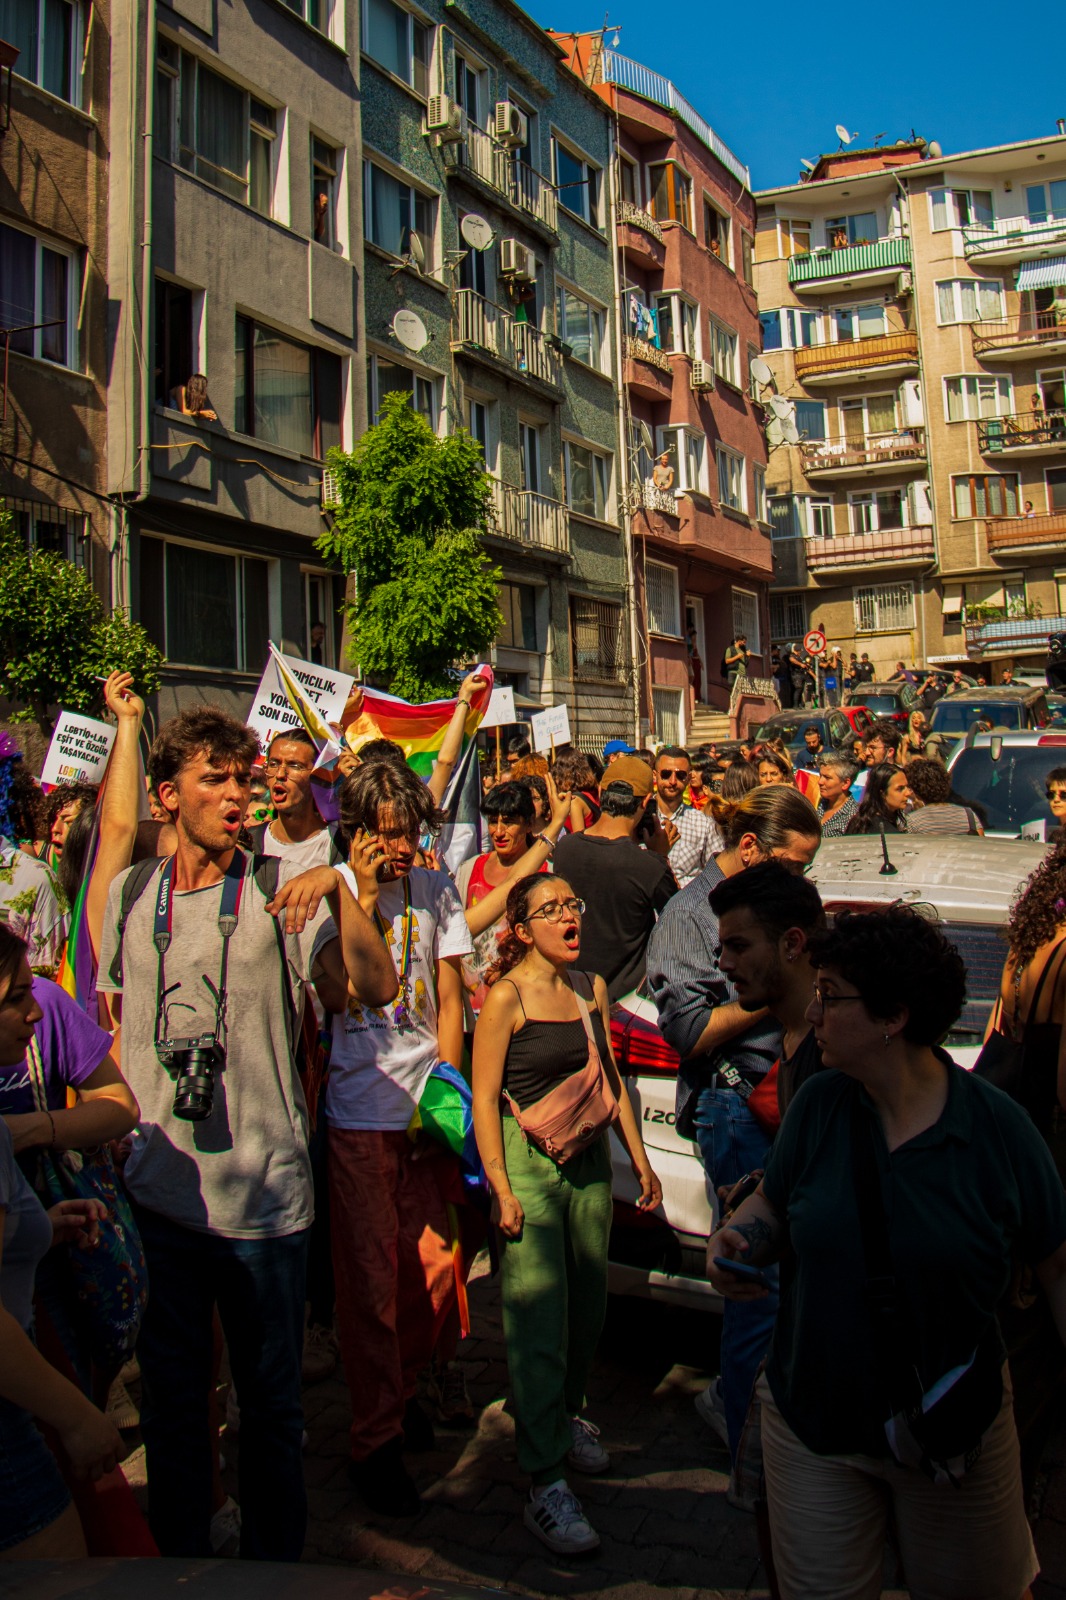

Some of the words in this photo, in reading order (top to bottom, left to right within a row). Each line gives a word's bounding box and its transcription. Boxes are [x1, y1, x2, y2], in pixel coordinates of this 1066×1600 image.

[258, 705, 281, 720] SON
[56, 734, 74, 744] EŞİT
[75, 739, 85, 748] VE
[85, 741, 109, 757] ÖZGÜR
[59, 746, 101, 765] YAŞAYACAK
[158, 878, 170, 916] Canon
